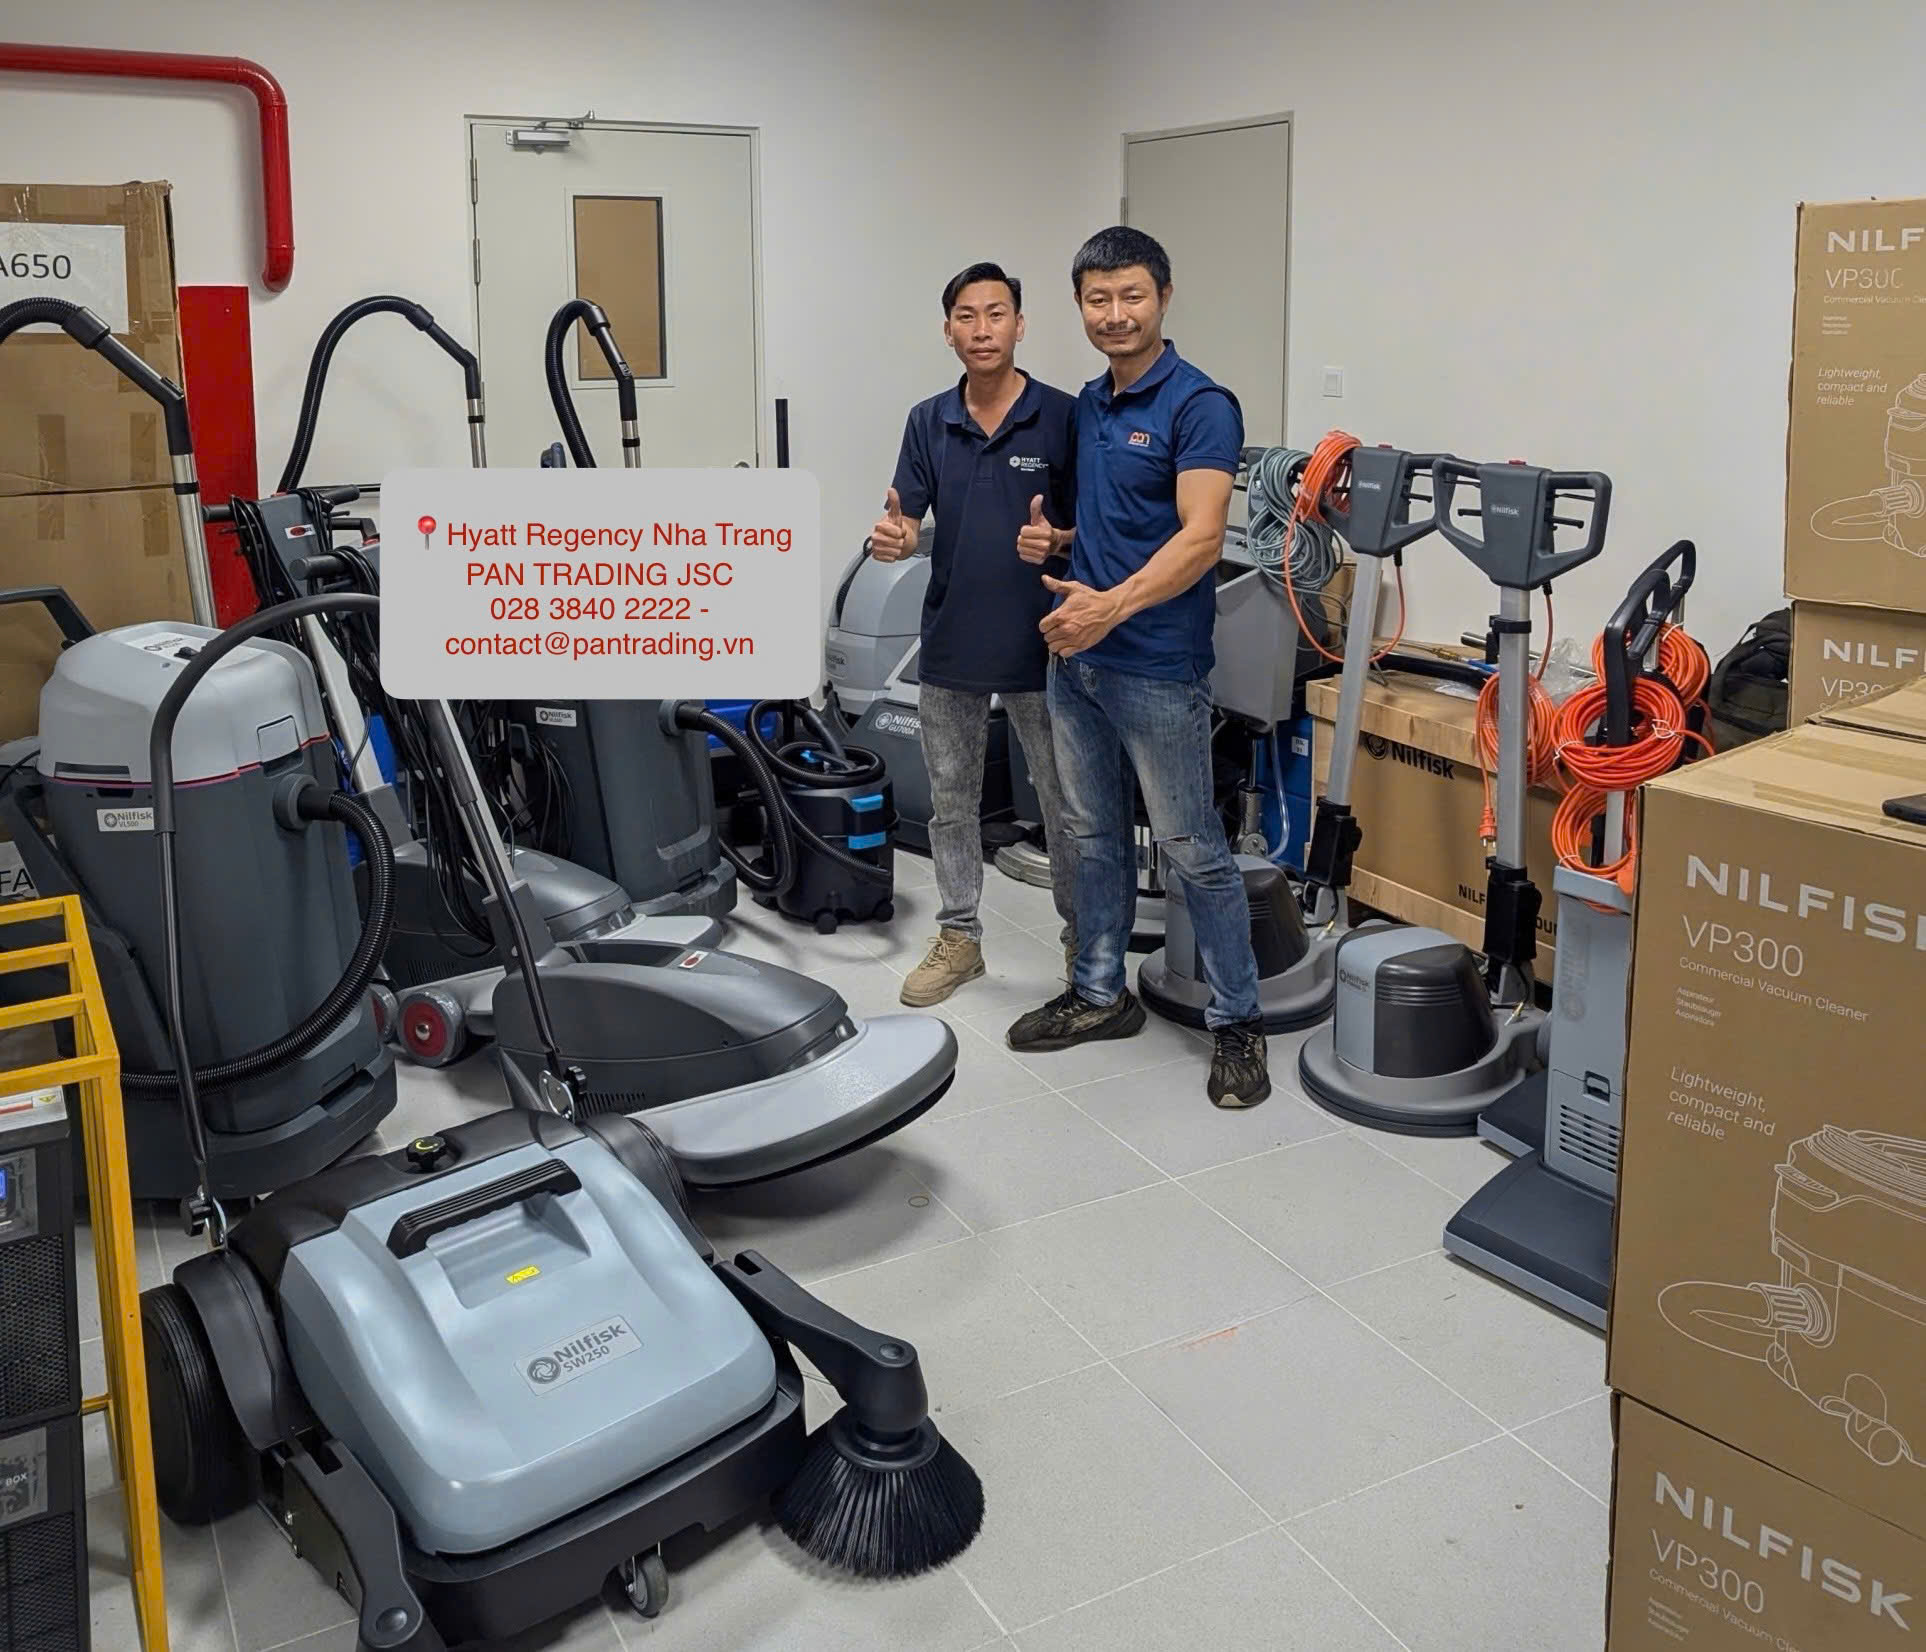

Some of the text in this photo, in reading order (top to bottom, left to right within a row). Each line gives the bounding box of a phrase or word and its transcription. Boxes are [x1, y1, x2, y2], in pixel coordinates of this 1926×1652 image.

[1818, 368, 1881, 380] Lightweight,
[1818, 382, 1888, 393] compact and
[1816, 395, 1855, 406] reliable
[892, 714, 922, 729] Nilfis
[1391, 740, 1455, 780] Nilfisk
[117, 811, 153, 821] Nilfisk
[1458, 884, 1486, 905] NILF
[1682, 914, 1804, 977] VP300
[1679, 956, 1869, 1021] Commercial Vacuum Cleaner
[1671, 1065, 1766, 1113] Lightweight,
[1667, 1111, 1725, 1140] reliable
[1669, 1090, 1776, 1137] compact and
[553, 1324, 628, 1363] Nilfisk
[563, 1345, 610, 1373] SW250
[1651, 1528, 1764, 1614] VP300
[1655, 1471, 1913, 1632] NILFISK
[1649, 1567, 1720, 1615] Commercial
[1722, 1607, 1773, 1644] Vacuum
